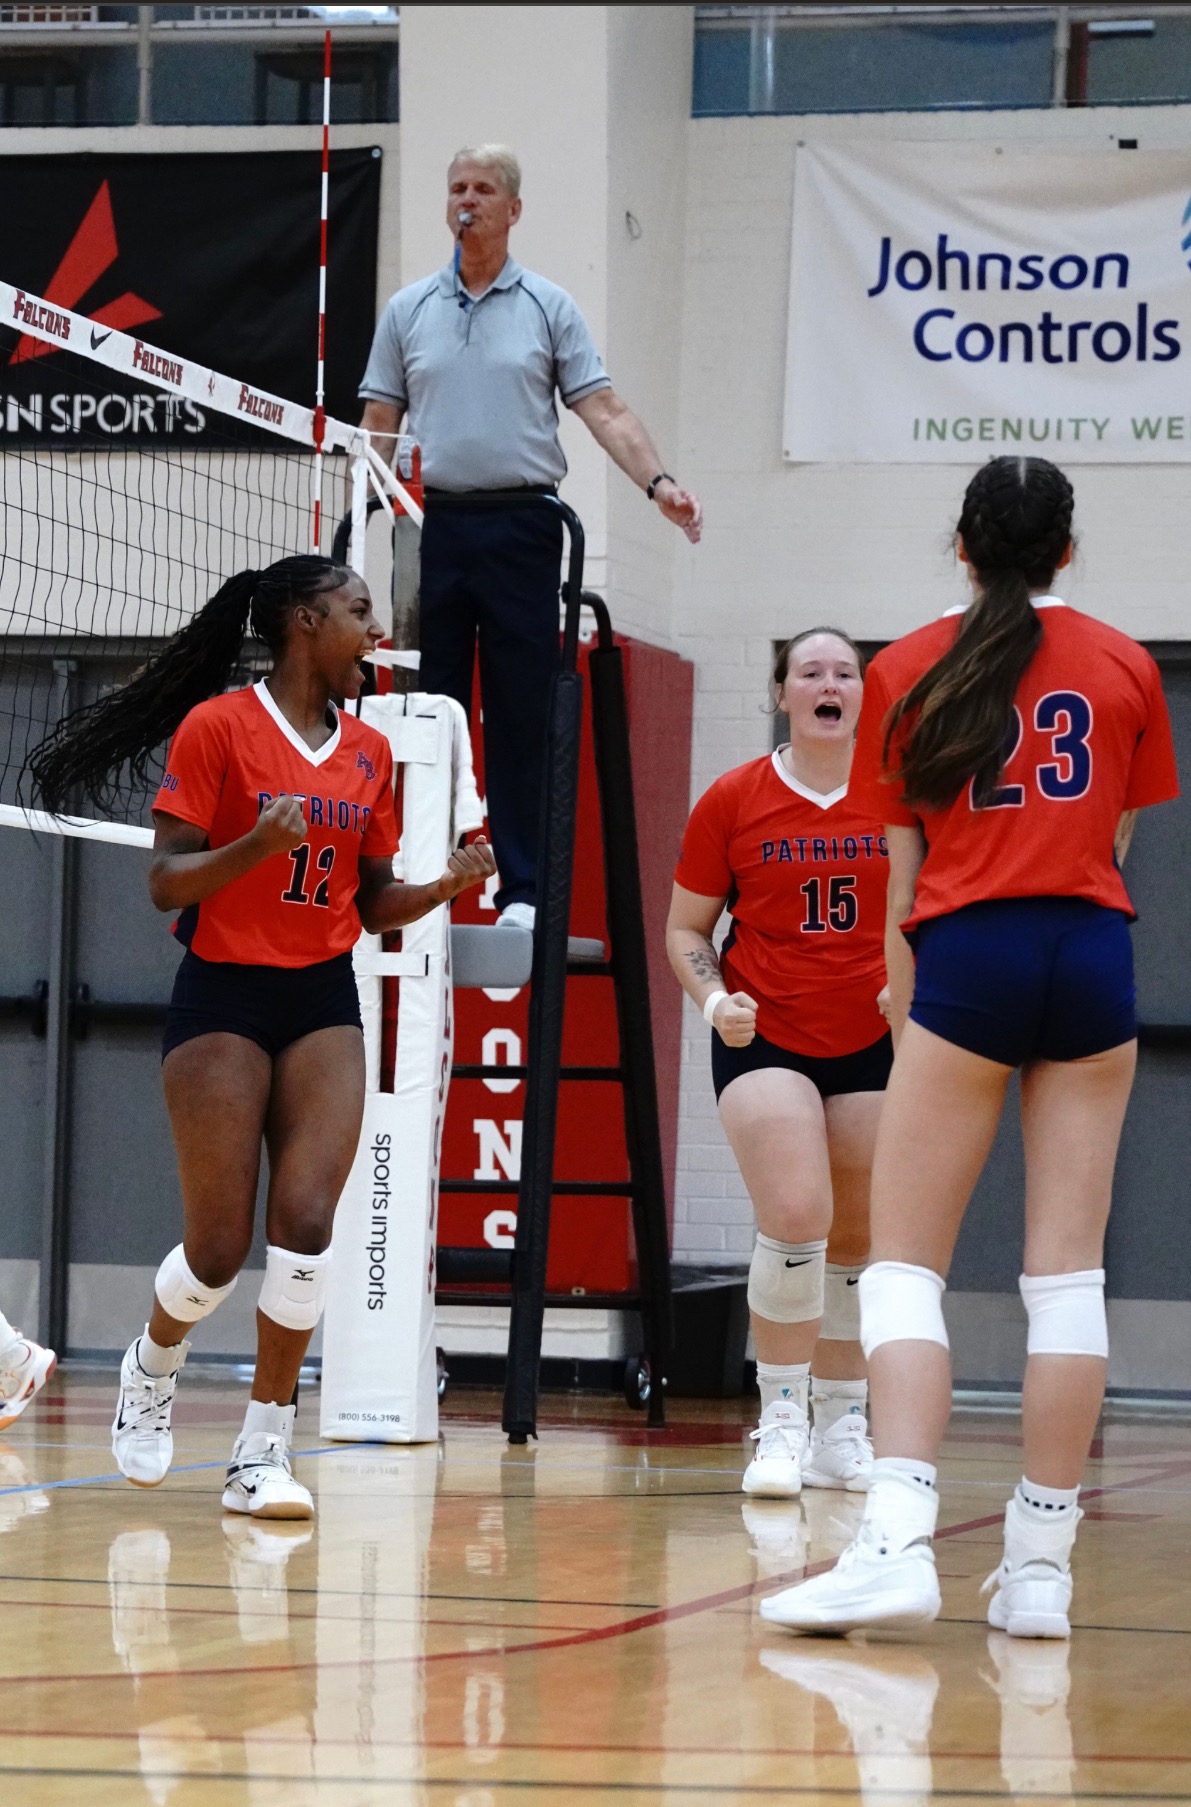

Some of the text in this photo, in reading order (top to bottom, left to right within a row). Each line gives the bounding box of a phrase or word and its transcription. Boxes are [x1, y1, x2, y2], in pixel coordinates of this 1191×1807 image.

[867, 233, 1129, 297] Johnson
[13, 289, 71, 340] FALCONS
[914, 302, 1181, 363] Controls
[132, 338, 184, 386] FALCONS
[50, 393, 206, 433] SPORTS
[237, 383, 285, 425] FALCONS
[913, 416, 1191, 441] INGENUITY WE
[258, 792, 371, 836] PRIOTS
[761, 835, 889, 864] PATRIOTS
[281, 842, 336, 909] 12
[800, 875, 858, 933] 15
[366, 1133, 391, 1310] sports imports
[338, 1413, 401, 1422] (800) 556-3198
